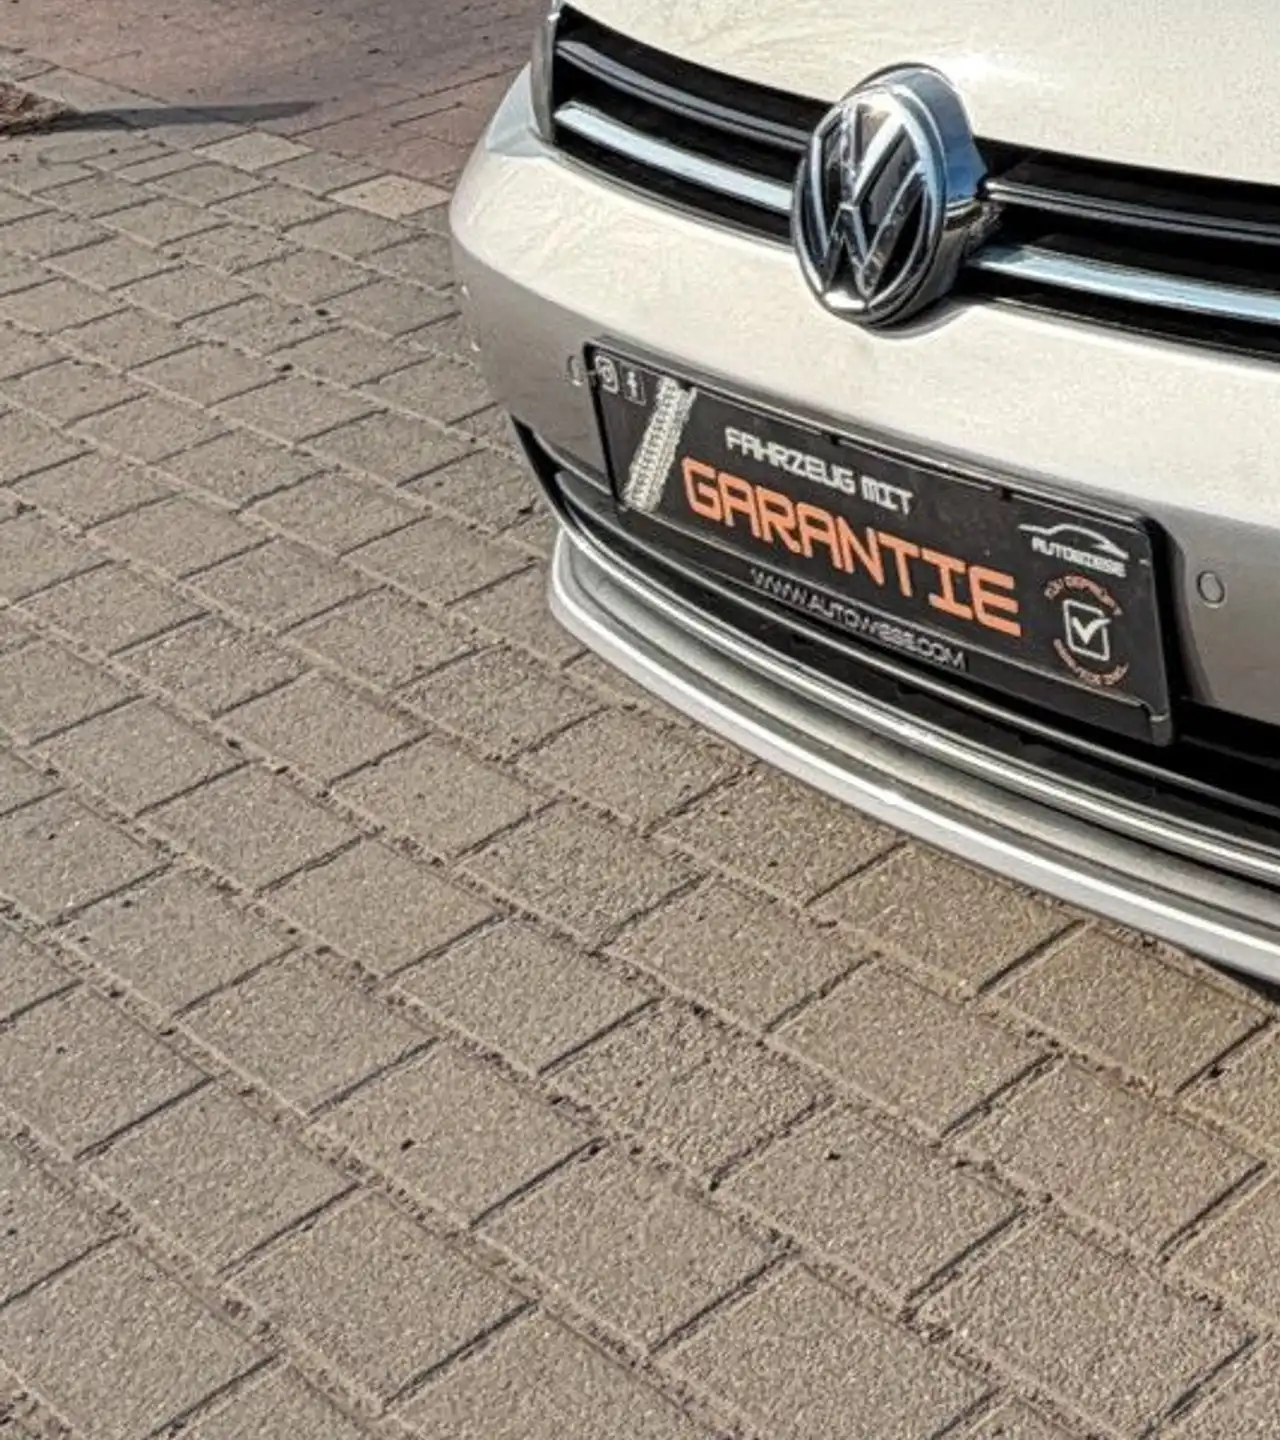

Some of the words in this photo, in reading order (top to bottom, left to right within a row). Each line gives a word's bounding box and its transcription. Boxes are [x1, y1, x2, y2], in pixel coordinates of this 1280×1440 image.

[725, 427, 856, 495] FAHRZEUG
[862, 465, 914, 517] MIT
[681, 456, 1022, 638] GARANTIE
